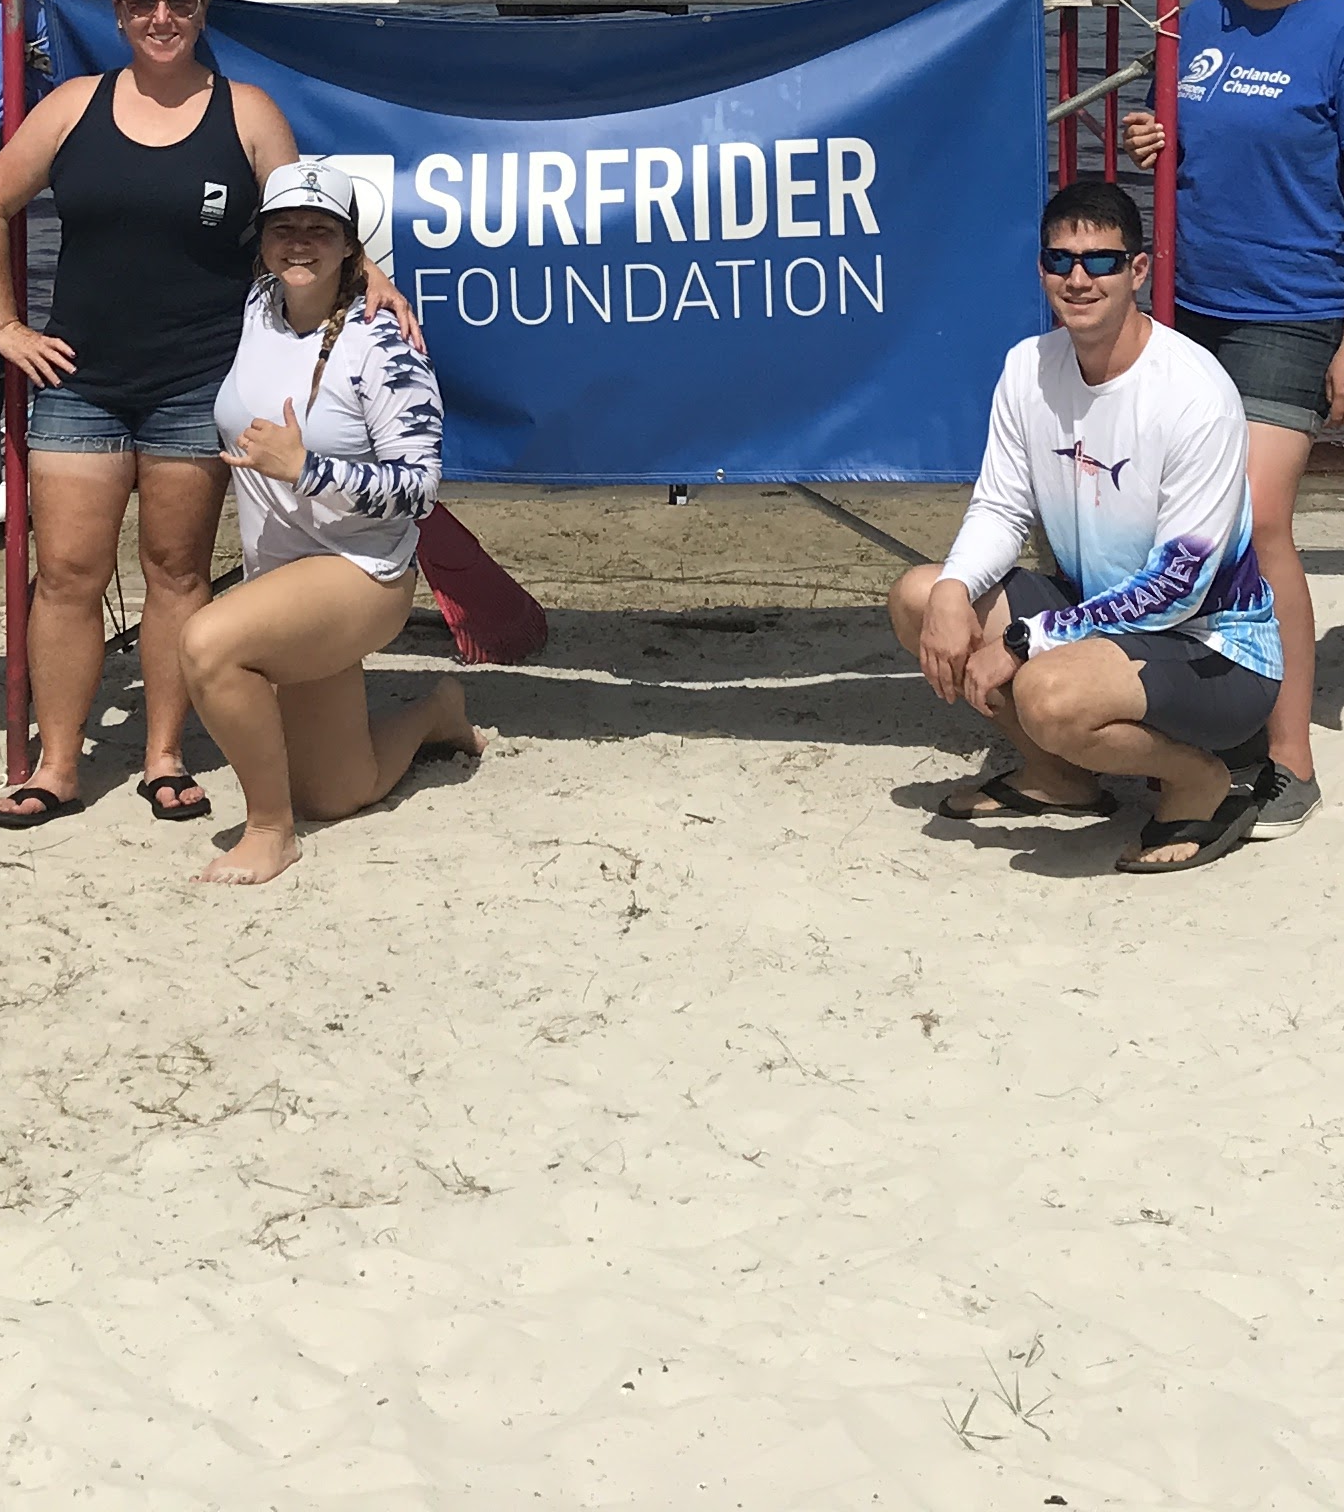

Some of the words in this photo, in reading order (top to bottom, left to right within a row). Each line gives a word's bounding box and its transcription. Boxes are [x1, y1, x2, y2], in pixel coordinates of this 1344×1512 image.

[1222, 79, 1283, 99] Chapter
[1230, 65, 1291, 85] Orlando
[412, 137, 880, 249] SURFRIDER
[414, 254, 884, 327] FOUNDATION
